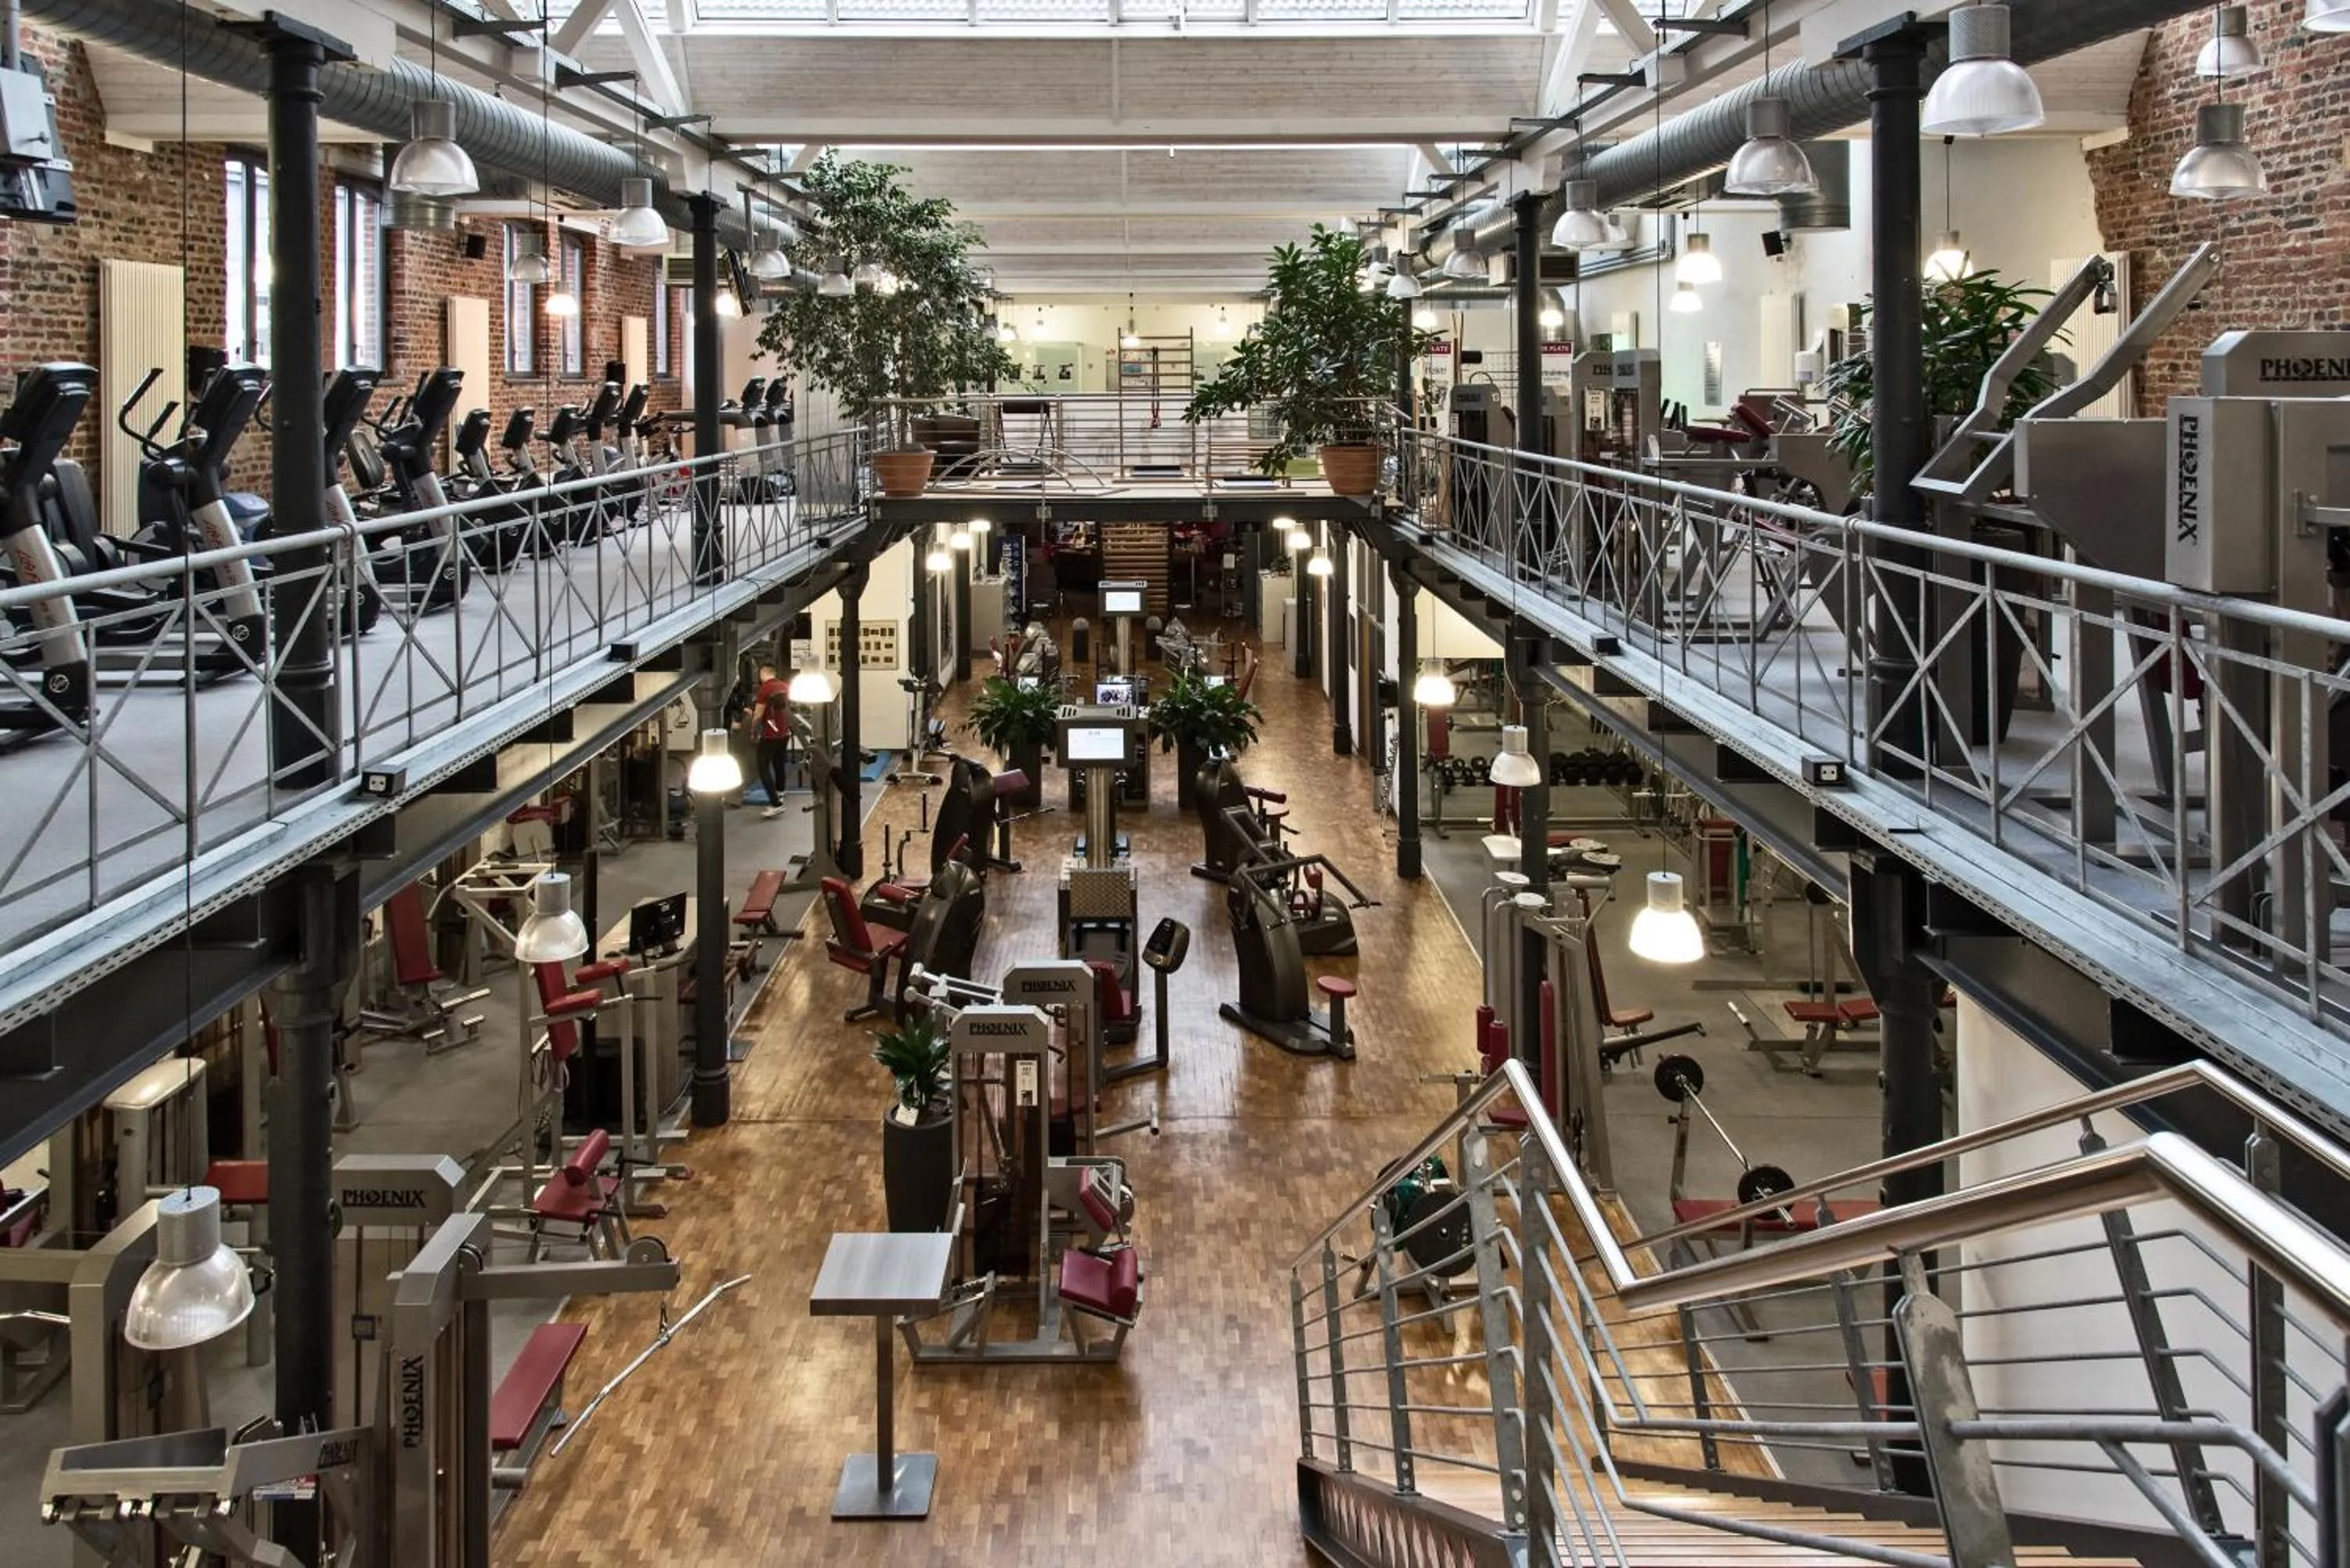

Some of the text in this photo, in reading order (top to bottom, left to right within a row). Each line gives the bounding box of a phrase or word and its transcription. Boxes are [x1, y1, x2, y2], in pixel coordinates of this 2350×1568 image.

[2259, 358, 2350, 381] PHOENI
[2178, 415, 2198, 546] PHOENIX
[969, 1023, 1028, 1035] PHOENIX
[342, 1189, 427, 1208] PHOENIX
[403, 1354, 424, 1449] PHOENIX
